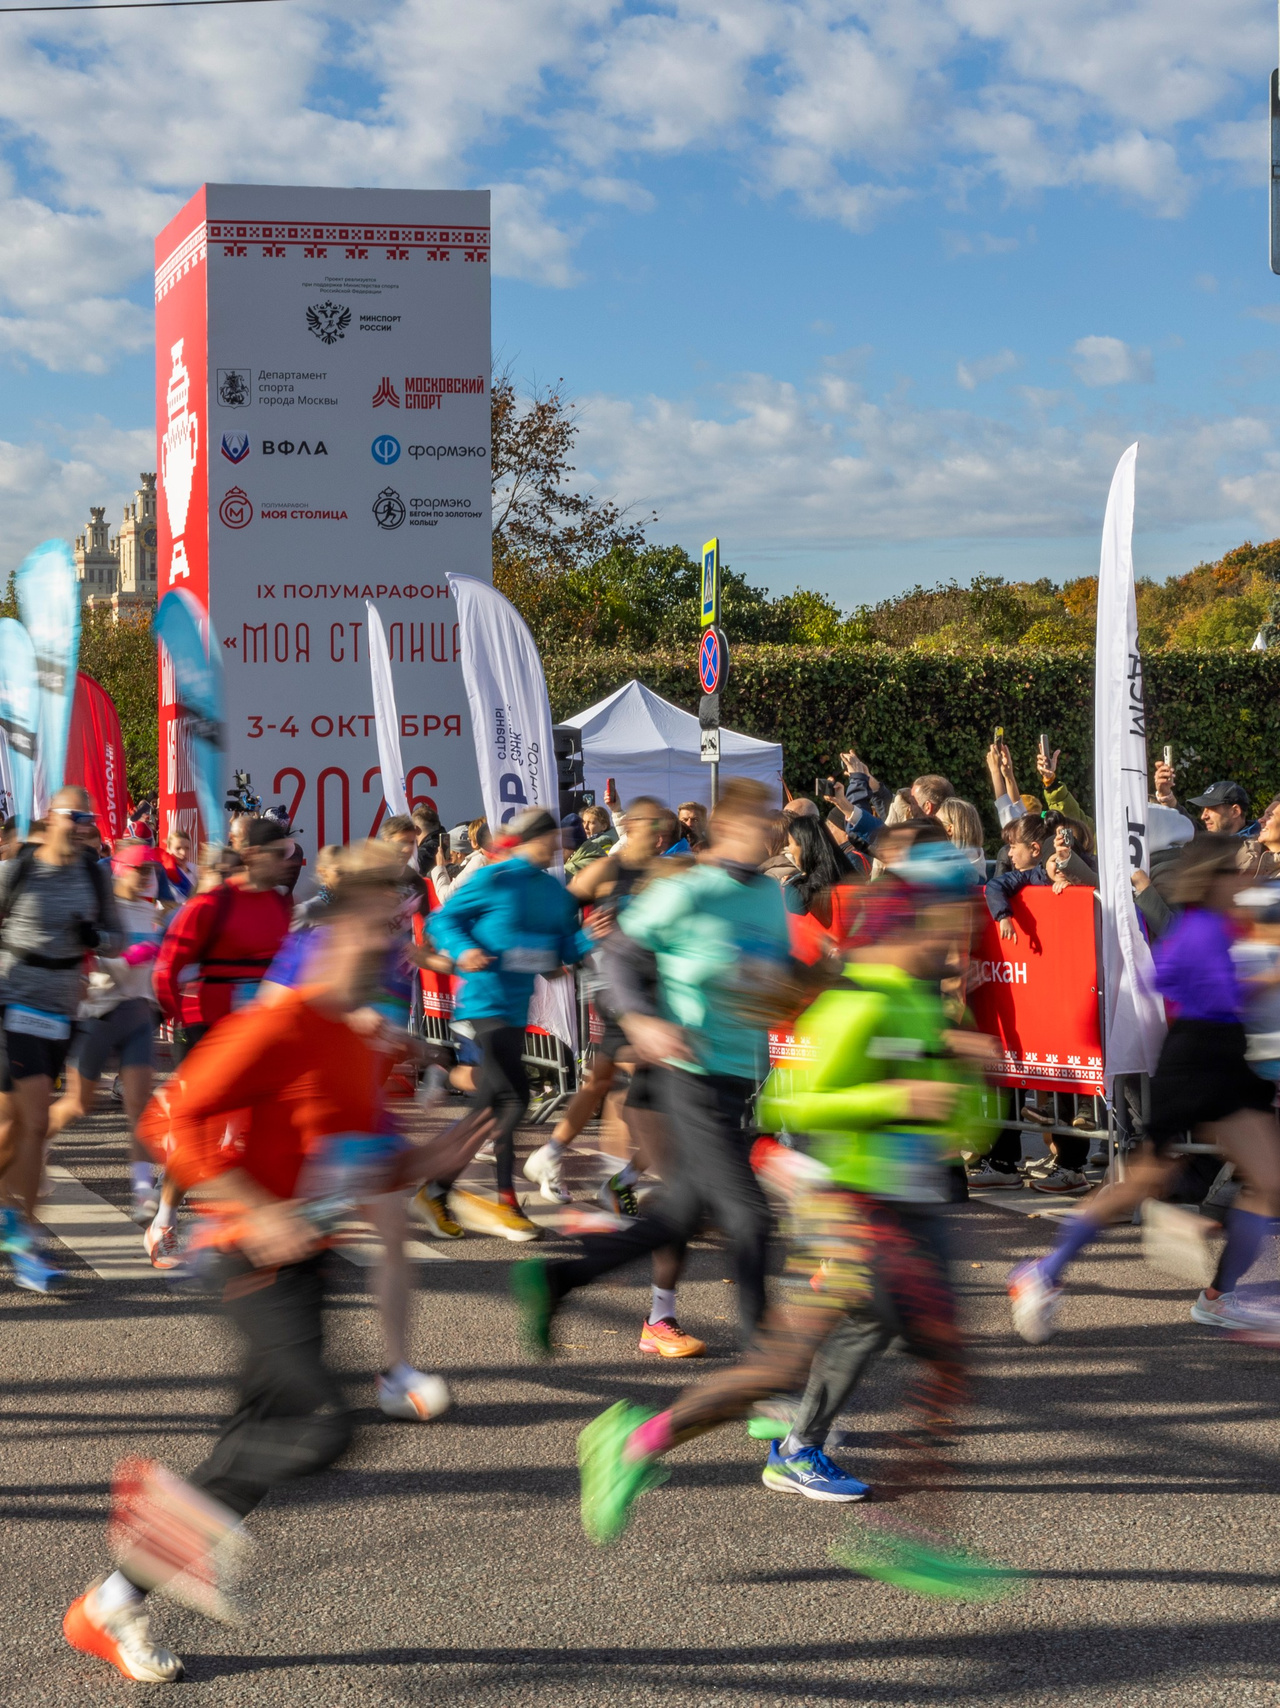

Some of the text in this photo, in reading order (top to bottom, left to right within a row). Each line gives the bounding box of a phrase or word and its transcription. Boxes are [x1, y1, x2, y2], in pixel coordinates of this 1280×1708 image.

[258, 370, 327, 381] Департамент
[258, 382, 294, 395] спорта
[405, 375, 485, 395] МОСКОВСКИЙ
[258, 395, 338, 407] города Москвы
[405, 394, 442, 409] СПОРТ
[262, 440, 328, 456] ВФЛА
[408, 443, 486, 461] фармэко
[409, 498, 471, 510] фармэко
[261, 509, 348, 520] МОЯ СТОЛИЦА
[409, 510, 434, 518] БЕГОМ
[446, 511, 483, 519] ЗОЛОТОМУ
[409, 519, 438, 527] КОЛЬЦУ
[257, 584, 449, 599] IX ПОЛУМАРАФОН
[247, 715, 461, 738] 3-4 ОКТБРЯ
